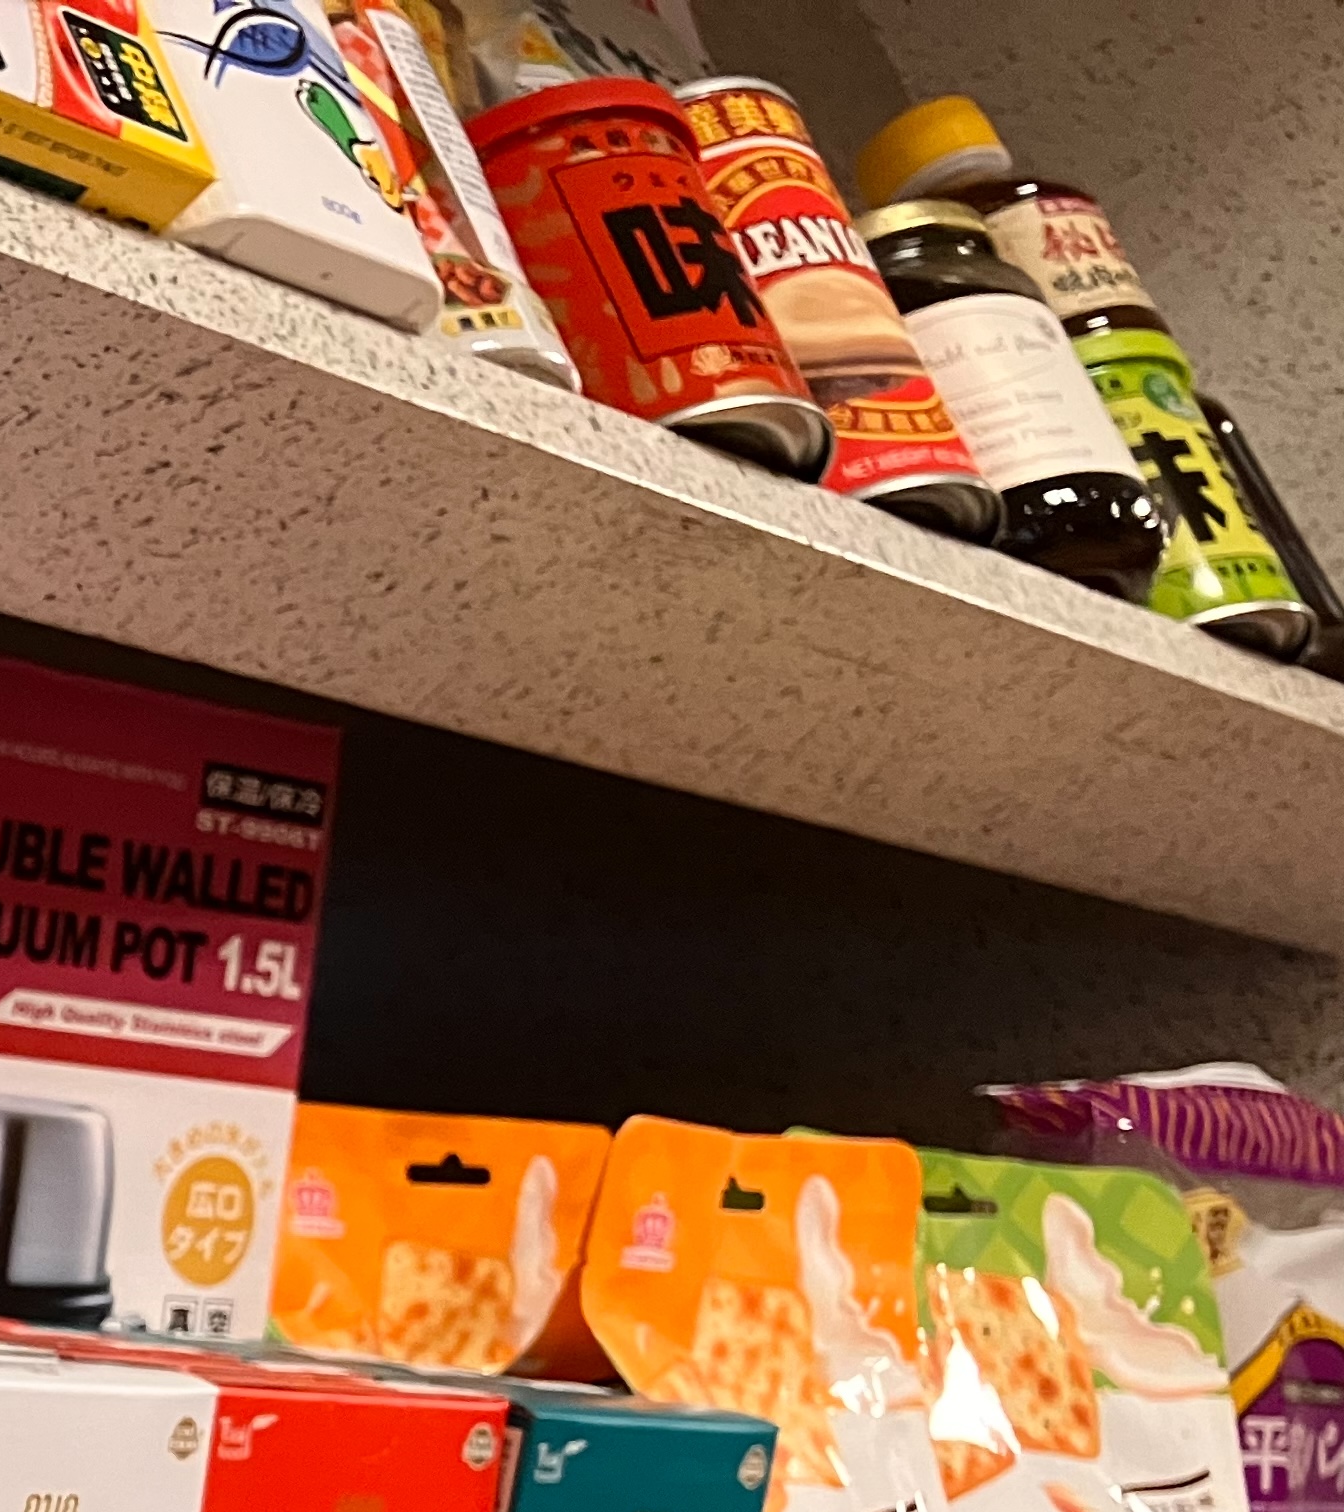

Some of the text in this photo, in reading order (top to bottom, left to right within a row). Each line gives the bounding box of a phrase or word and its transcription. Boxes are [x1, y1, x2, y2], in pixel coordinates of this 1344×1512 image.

[121, 839, 314, 924] WALLED
[111, 919, 208, 984] POT
[215, 935, 302, 1002] 1.5L
